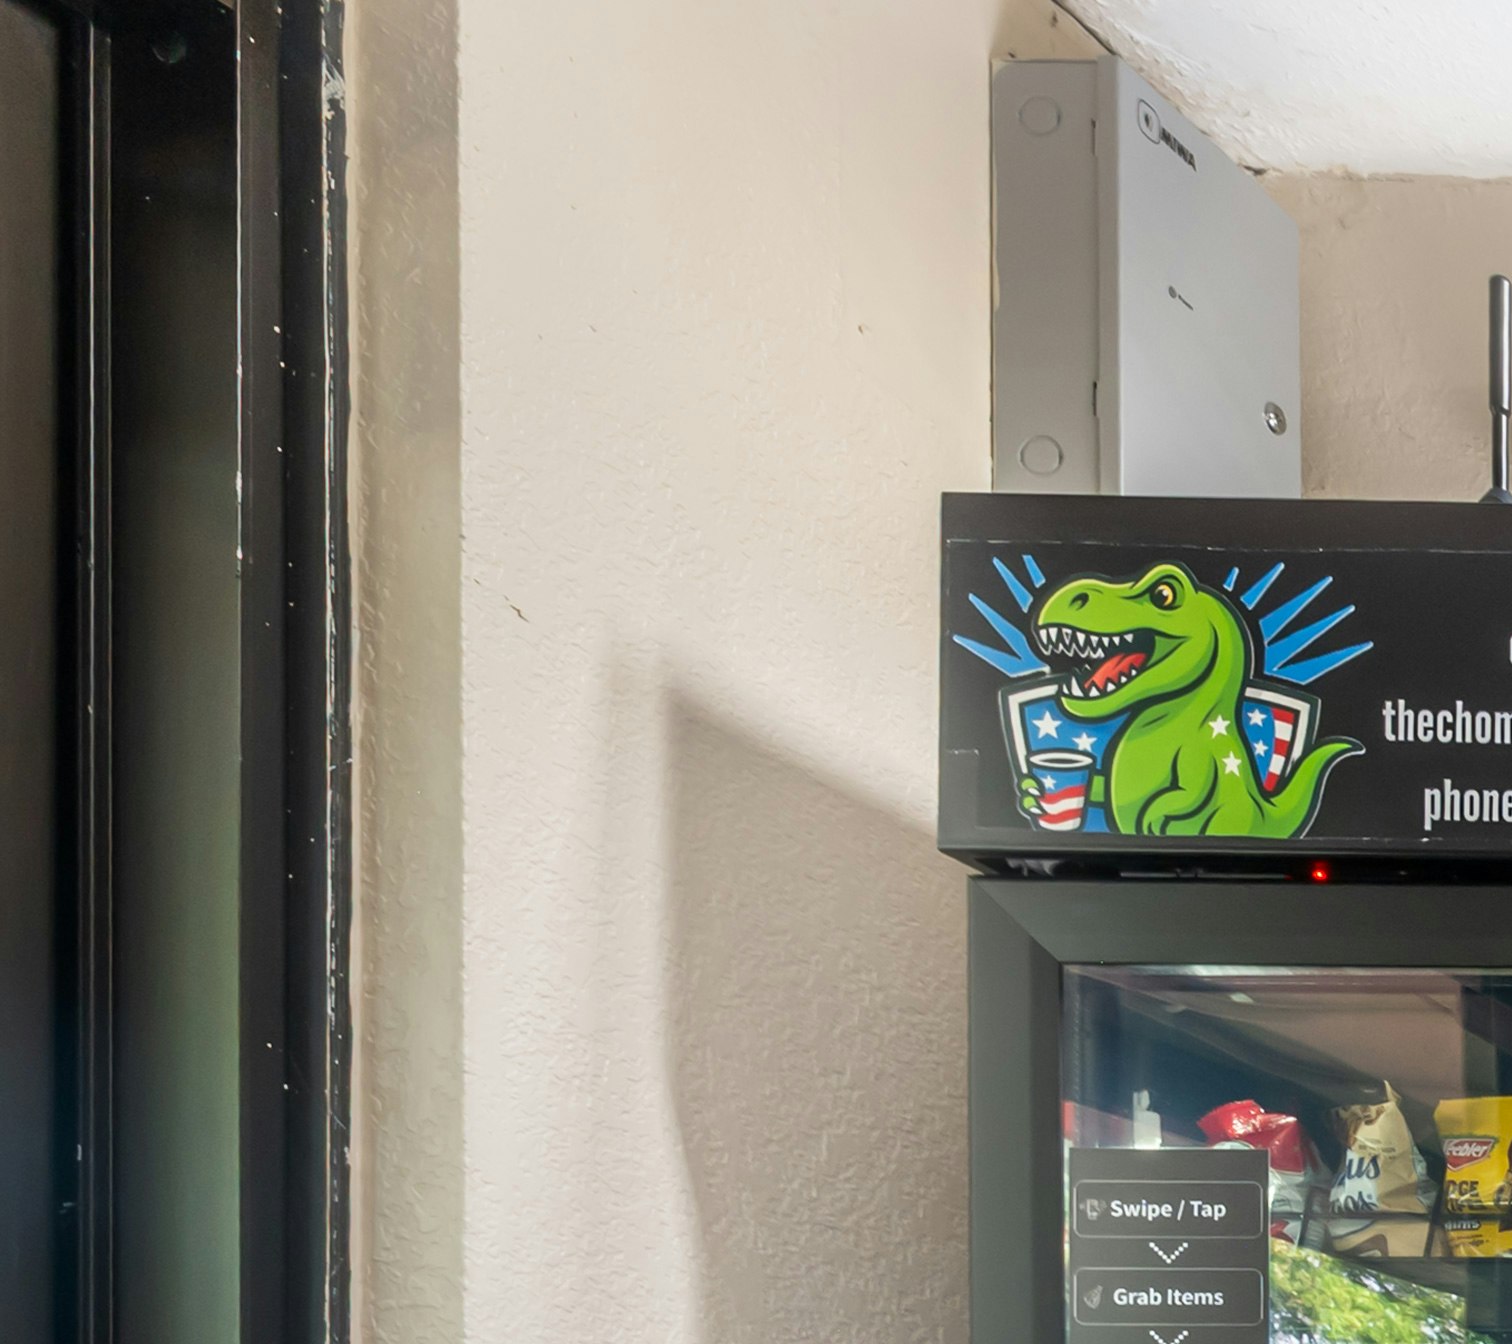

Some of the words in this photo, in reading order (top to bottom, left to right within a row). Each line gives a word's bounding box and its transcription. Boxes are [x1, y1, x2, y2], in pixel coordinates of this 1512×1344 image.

[1111, 1201, 1172, 1220] Swipe
[1191, 1201, 1226, 1220] Tap
[1114, 1288, 1161, 1306] Grab
[1167, 1289, 1224, 1306] Items
